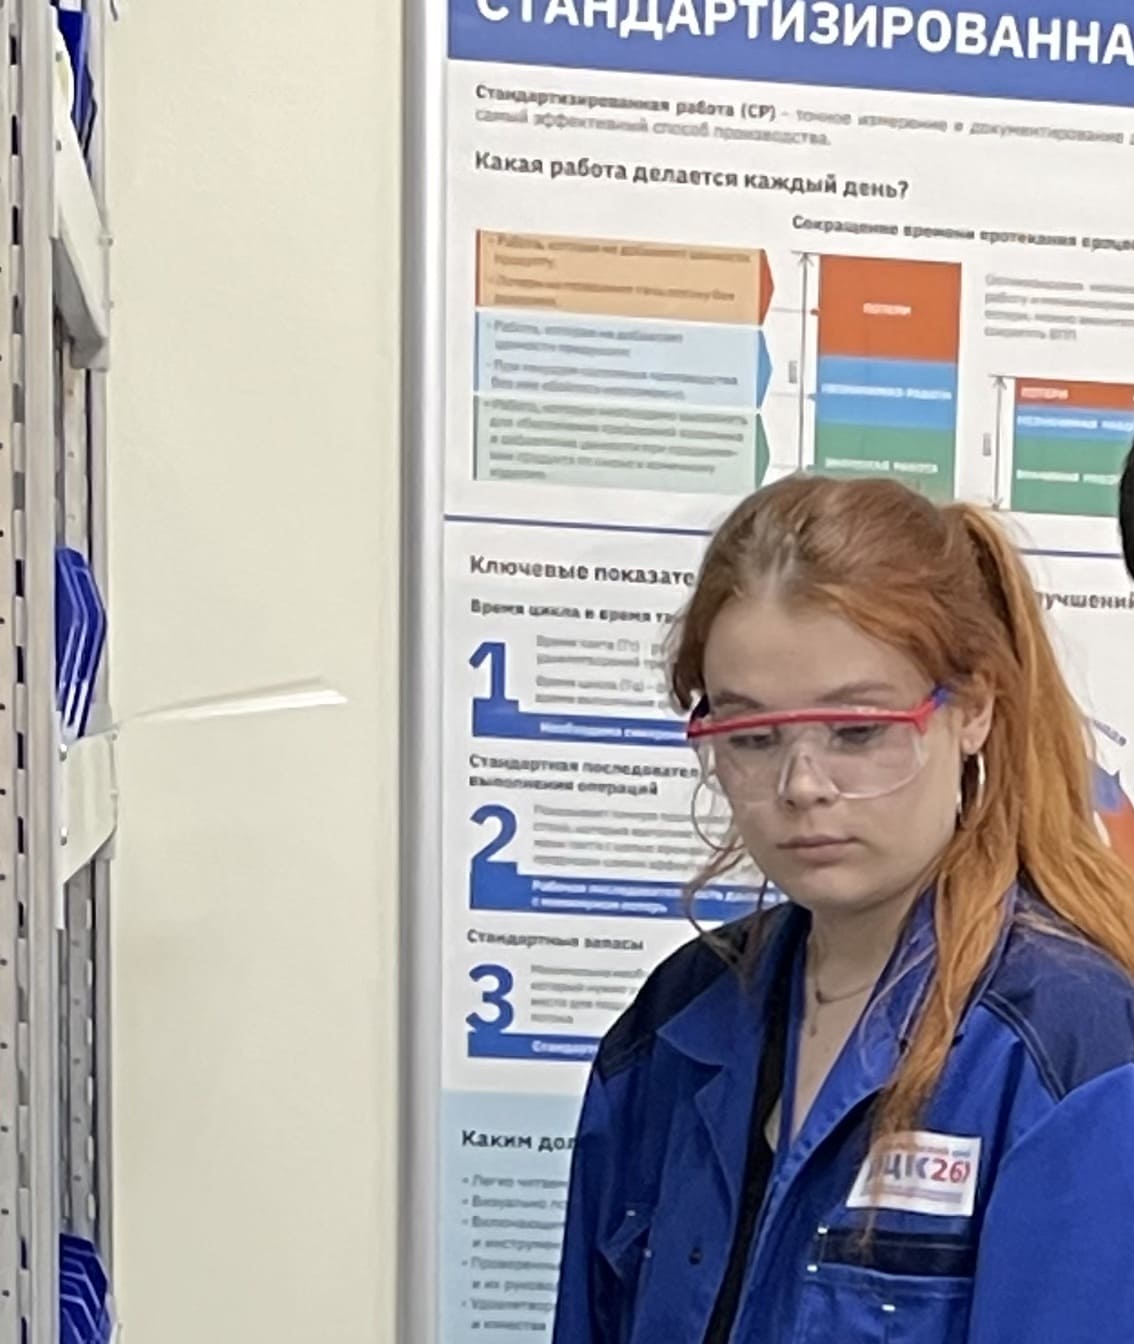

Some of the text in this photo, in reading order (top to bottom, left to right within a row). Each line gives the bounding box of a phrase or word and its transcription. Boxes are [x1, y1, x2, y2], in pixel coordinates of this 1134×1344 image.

[475, 84, 670, 113] Стандартизированная
[676, 100, 735, 118] работа
[740, 101, 777, 122] (СР)
[474, 150, 910, 200] Какая работа делается каждый день?
[469, 554, 696, 588] Ключевые показате
[468, 641, 518, 705] 1
[468, 753, 579, 773] Стандартная
[469, 804, 518, 868] 2
[465, 963, 515, 1033] 3
[461, 1129, 533, 1149] Каким
